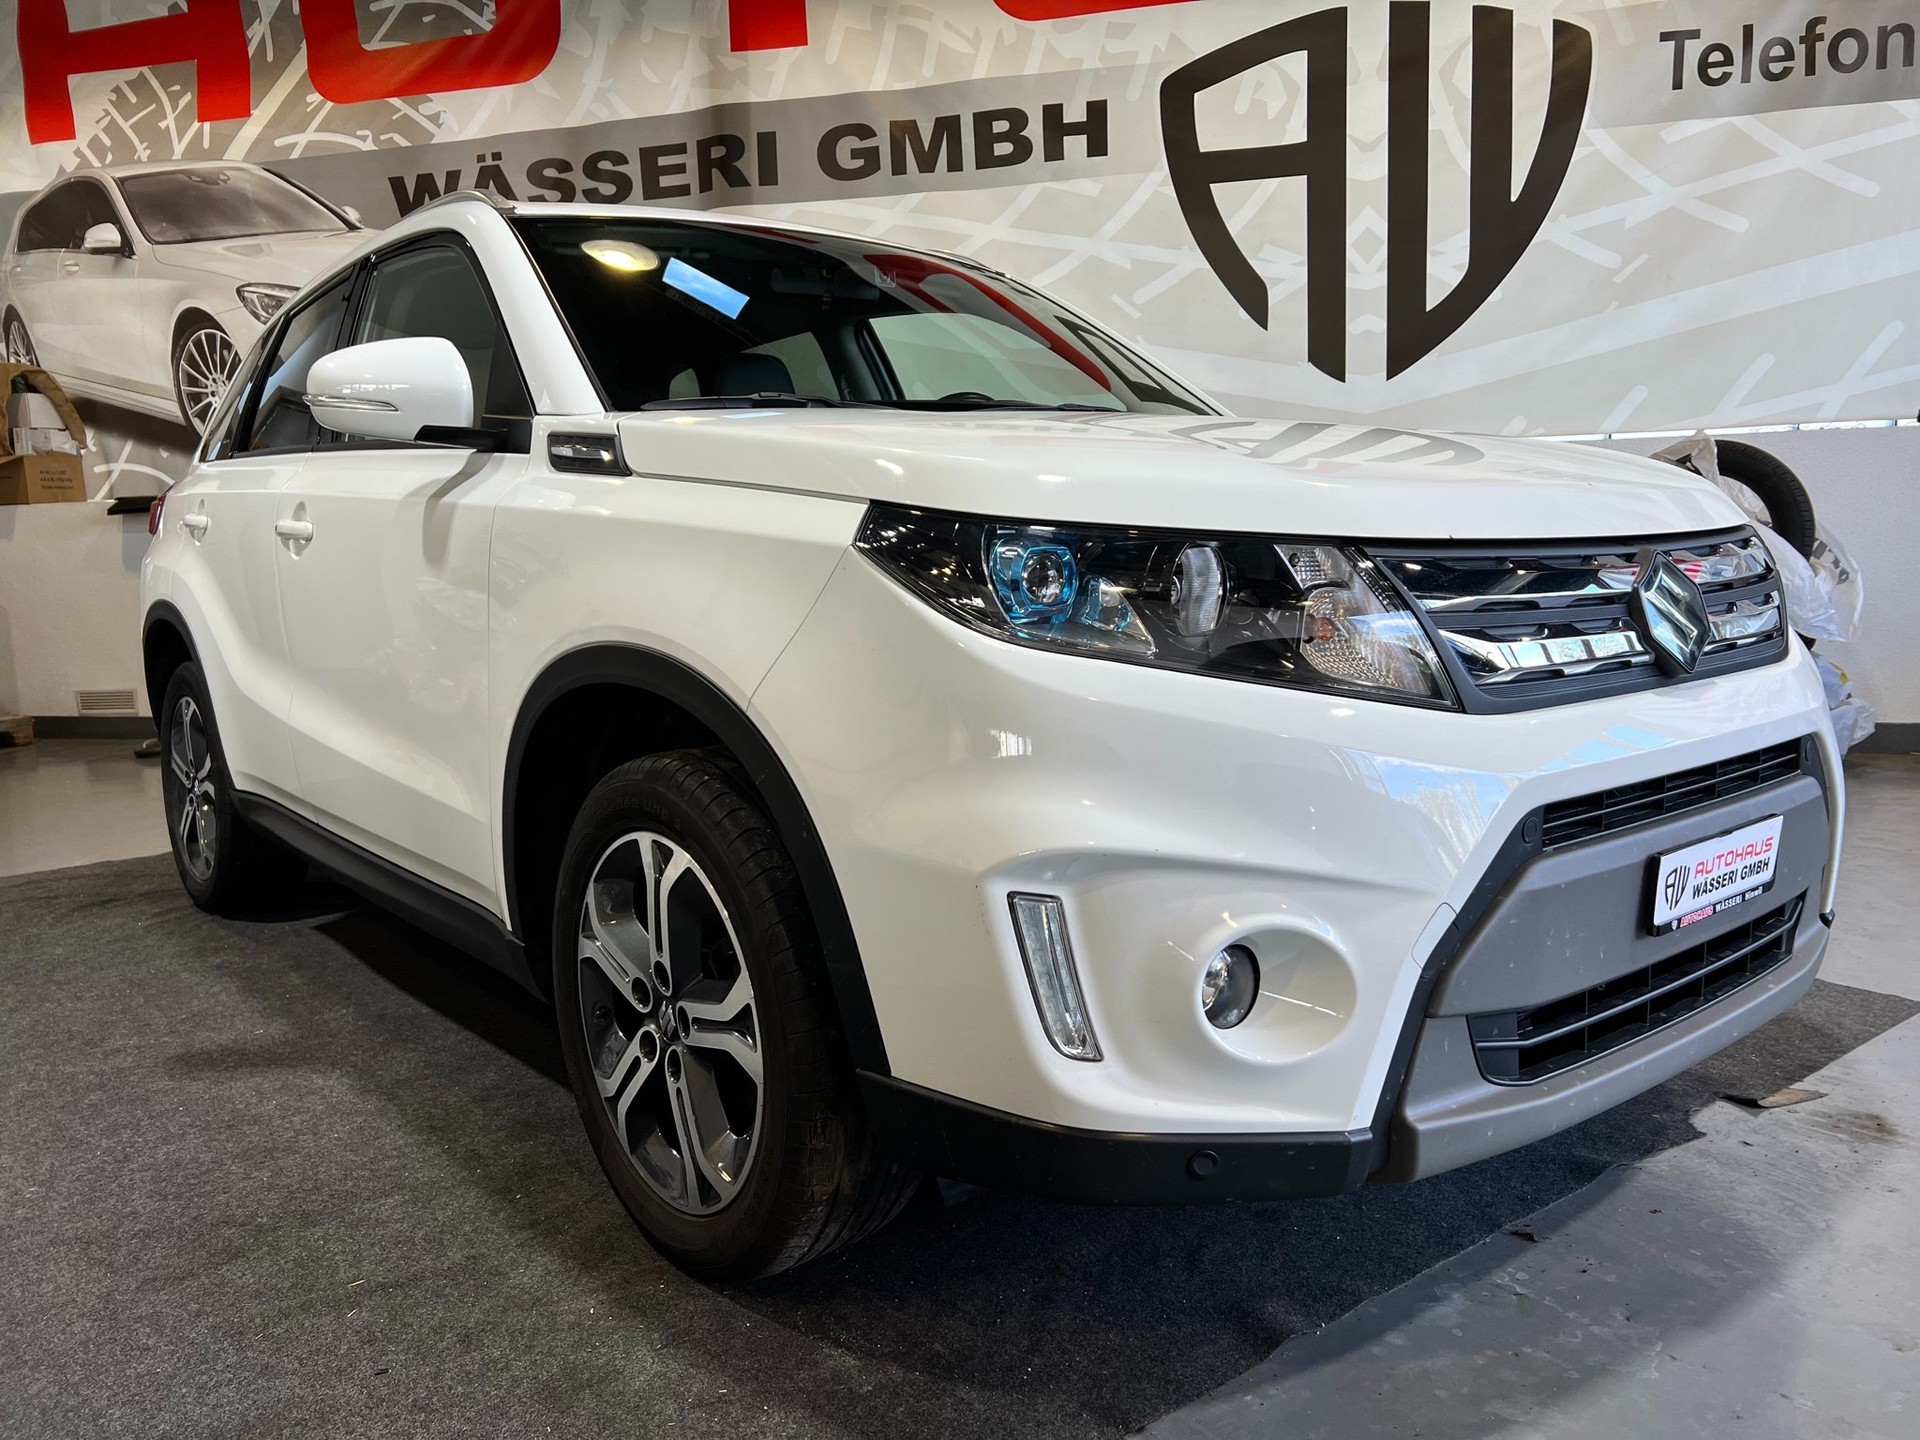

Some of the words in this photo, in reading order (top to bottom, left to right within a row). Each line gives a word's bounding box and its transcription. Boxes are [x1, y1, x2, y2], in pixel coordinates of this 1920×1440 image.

[1659, 16, 1915, 91] Telefon
[816, 99, 1109, 182] GMBH
[1692, 868, 1739, 900] WÄSSERI
[1740, 857, 1771, 881] GMBH
[1694, 836, 1774, 879] AUTOHAUS
